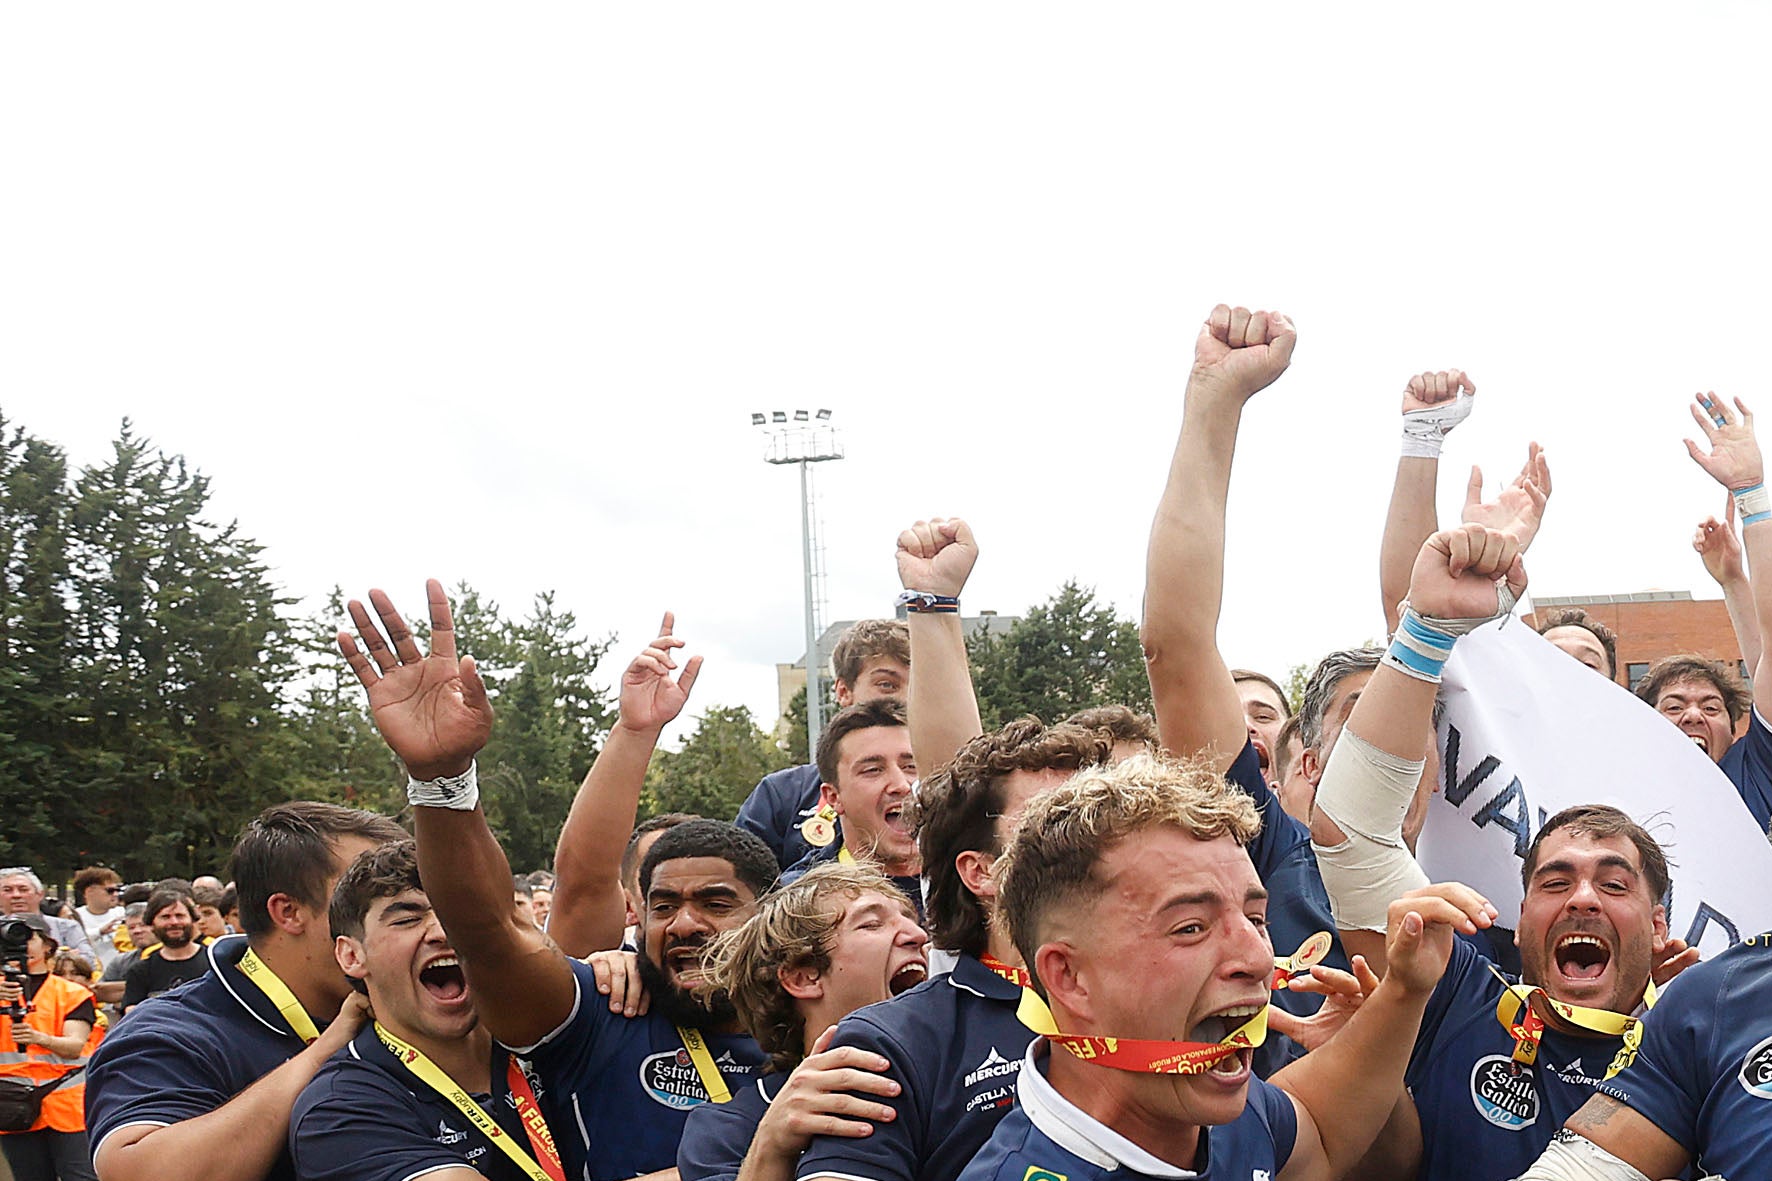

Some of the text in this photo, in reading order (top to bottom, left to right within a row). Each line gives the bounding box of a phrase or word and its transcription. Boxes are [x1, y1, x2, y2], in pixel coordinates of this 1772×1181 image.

[719, 1065, 752, 1075] CURY
[964, 1058, 1026, 1088] MERCURY
[1148, 1057, 1171, 1070] RUGBY
[447, 1089, 490, 1135] FERugby
[966, 1087, 1008, 1112] CASTILLA
[1008, 1083, 1016, 1094] Y
